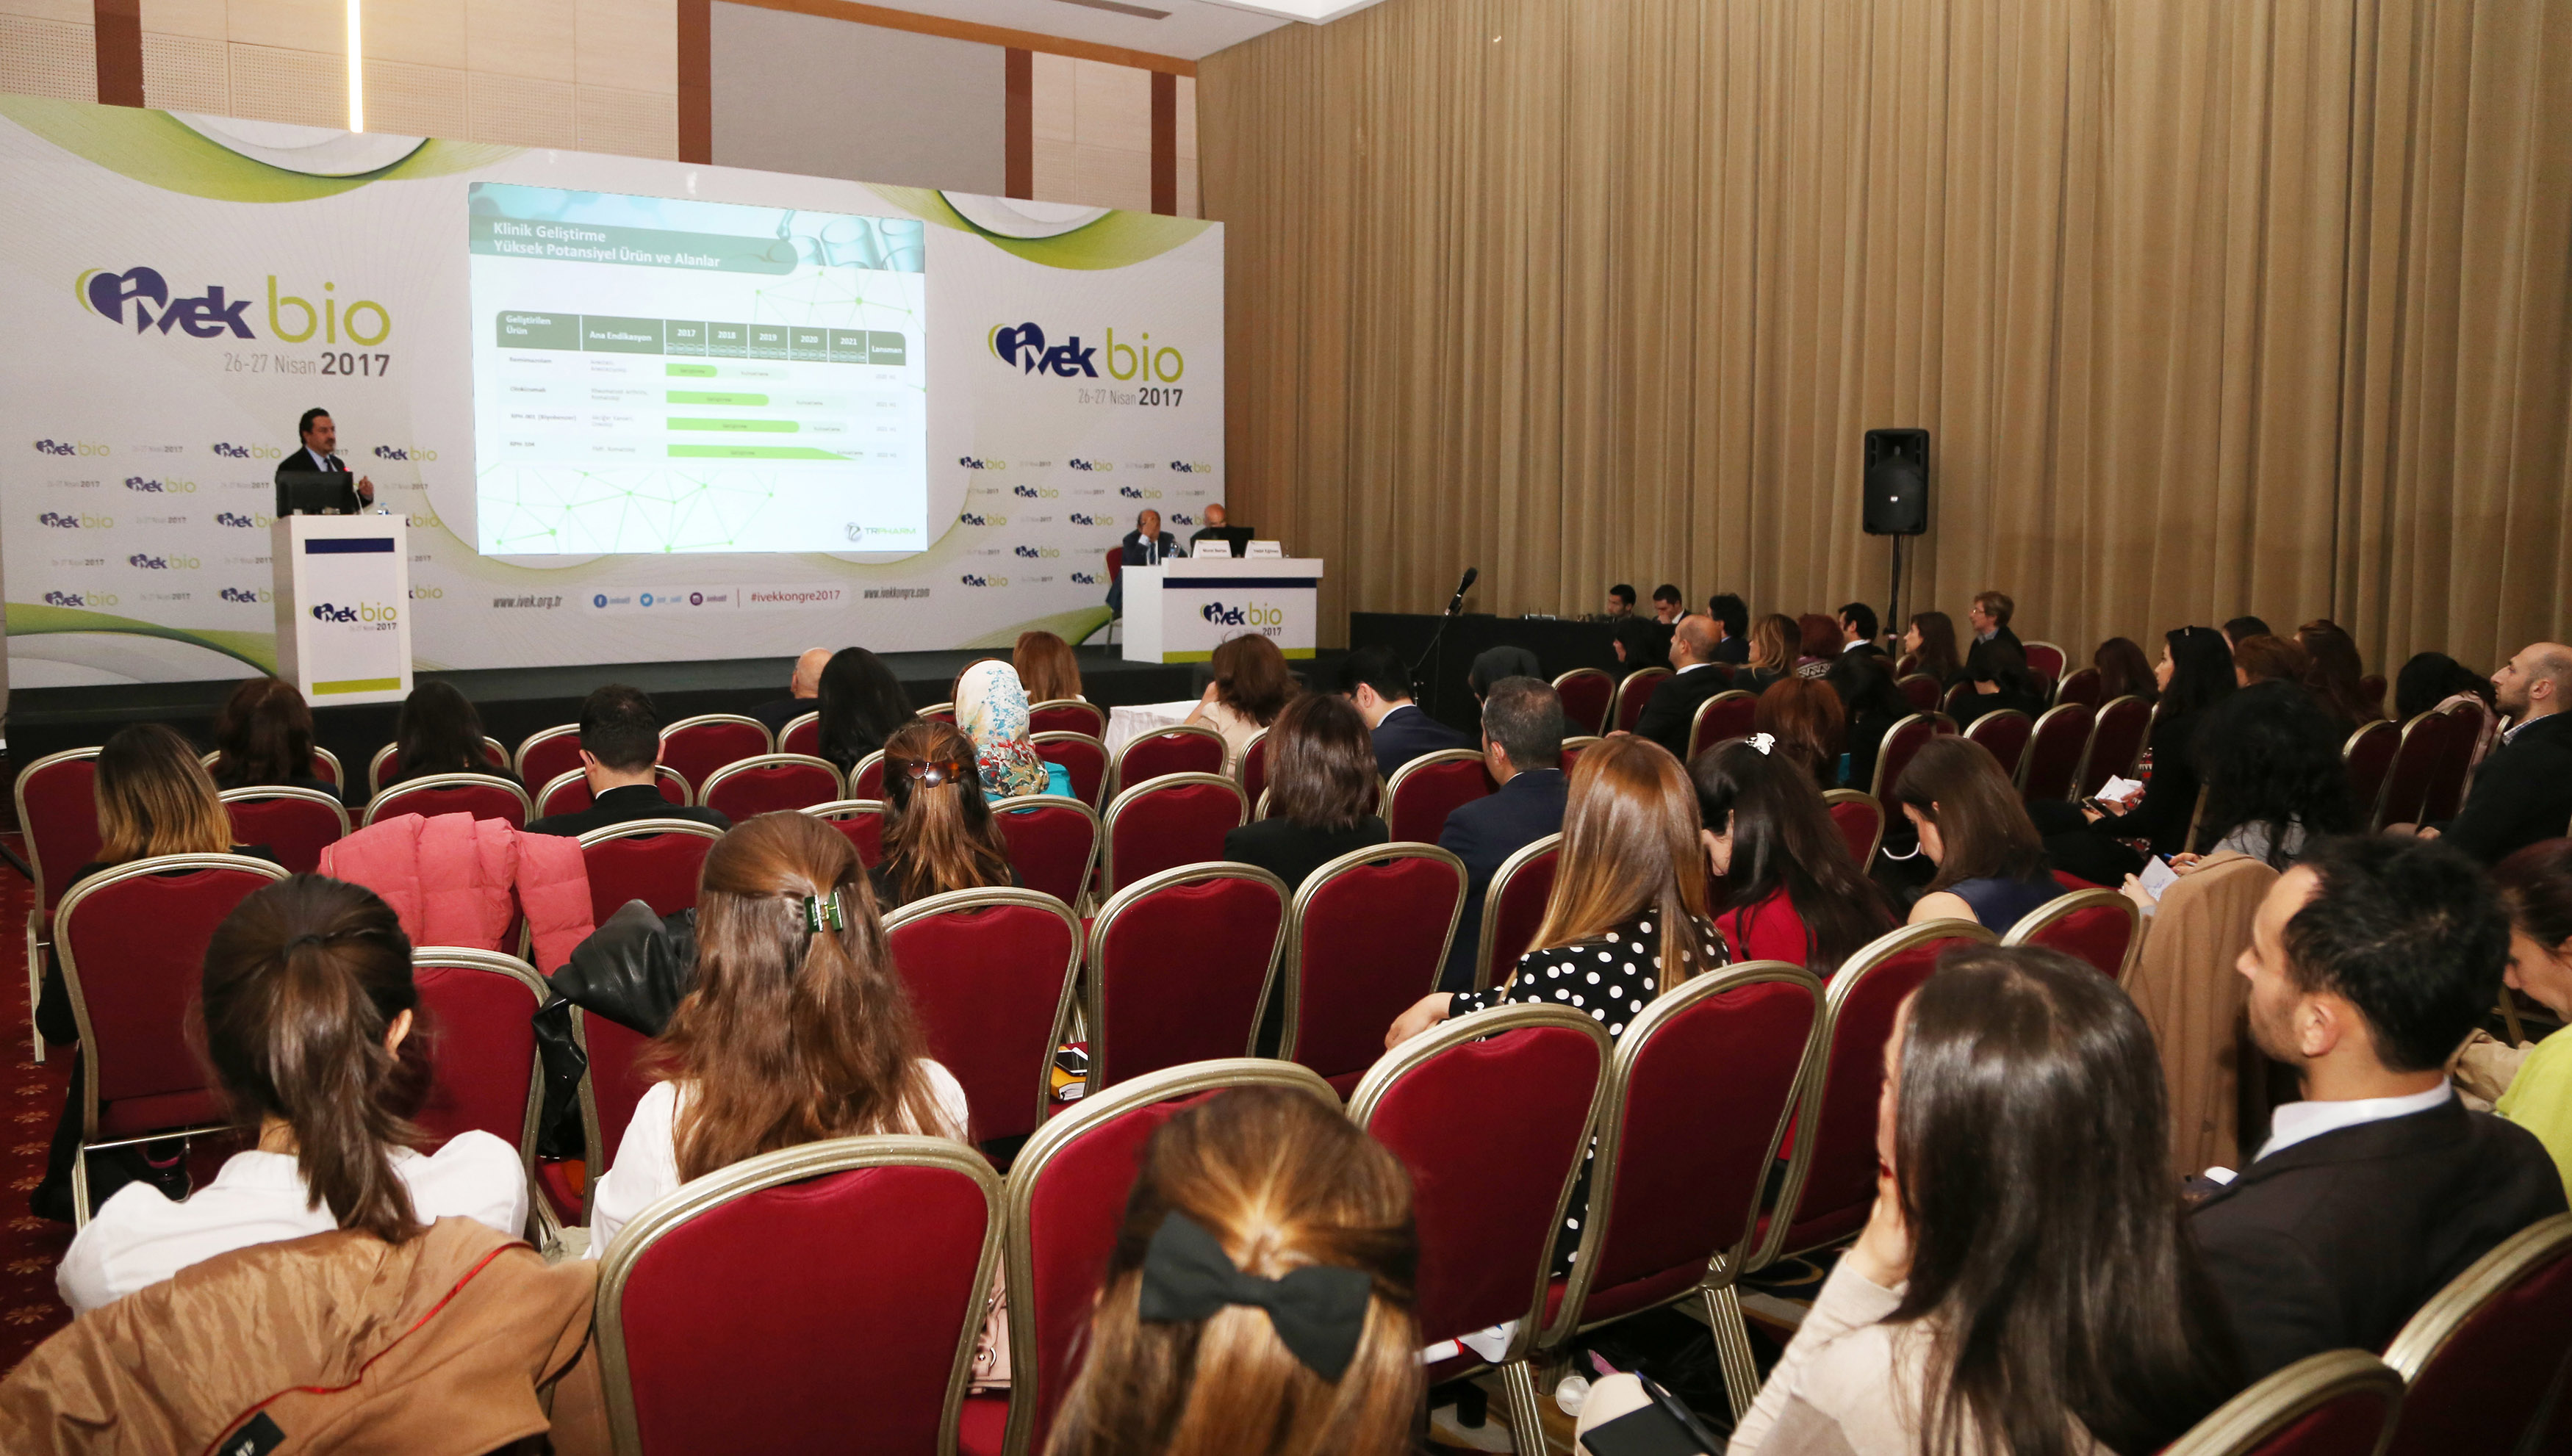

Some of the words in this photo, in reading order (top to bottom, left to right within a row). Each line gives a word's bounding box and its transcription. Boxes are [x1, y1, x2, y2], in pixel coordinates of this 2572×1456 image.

[494, 222, 533, 237] Klinik
[536, 225, 606, 242] Geliştirme
[494, 239, 542, 256] Yüksek
[547, 245, 616, 262] Potansiyel
[620, 246, 652, 262] Ürün
[655, 254, 671, 264] ve
[675, 252, 720, 267] Alanlar
[89, 266, 256, 339] ivek
[267, 275, 391, 346] bio
[506, 314, 552, 325] Geliştirilen
[506, 325, 528, 335] Ürün
[589, 331, 606, 339] Ana
[607, 332, 652, 342] Endikasyon
[677, 328, 696, 337] 2017
[718, 331, 736, 339] 2018
[759, 333, 777, 342] 2019
[800, 335, 818, 344] 2020
[840, 337, 858, 346] 2021
[872, 346, 902, 354] Lansman
[996, 322, 1099, 378] ivek
[1107, 327, 1184, 383] bio
[223, 353, 268, 372] 26-27
[275, 355, 316, 375] Nisan
[321, 352, 390, 377] 2017
[1079, 388, 1106, 404] 26-27
[1110, 390, 1136, 405] Nisan
[1139, 387, 1183, 407] 2017
[493, 595, 562, 609] www.ivek.org.tr
[751, 590, 841, 603] #ivekkongre2017
[361, 602, 397, 621] bio
[1249, 602, 1282, 625] bio
[377, 622, 397, 631] 2017
[1262, 627, 1282, 636] 2017
